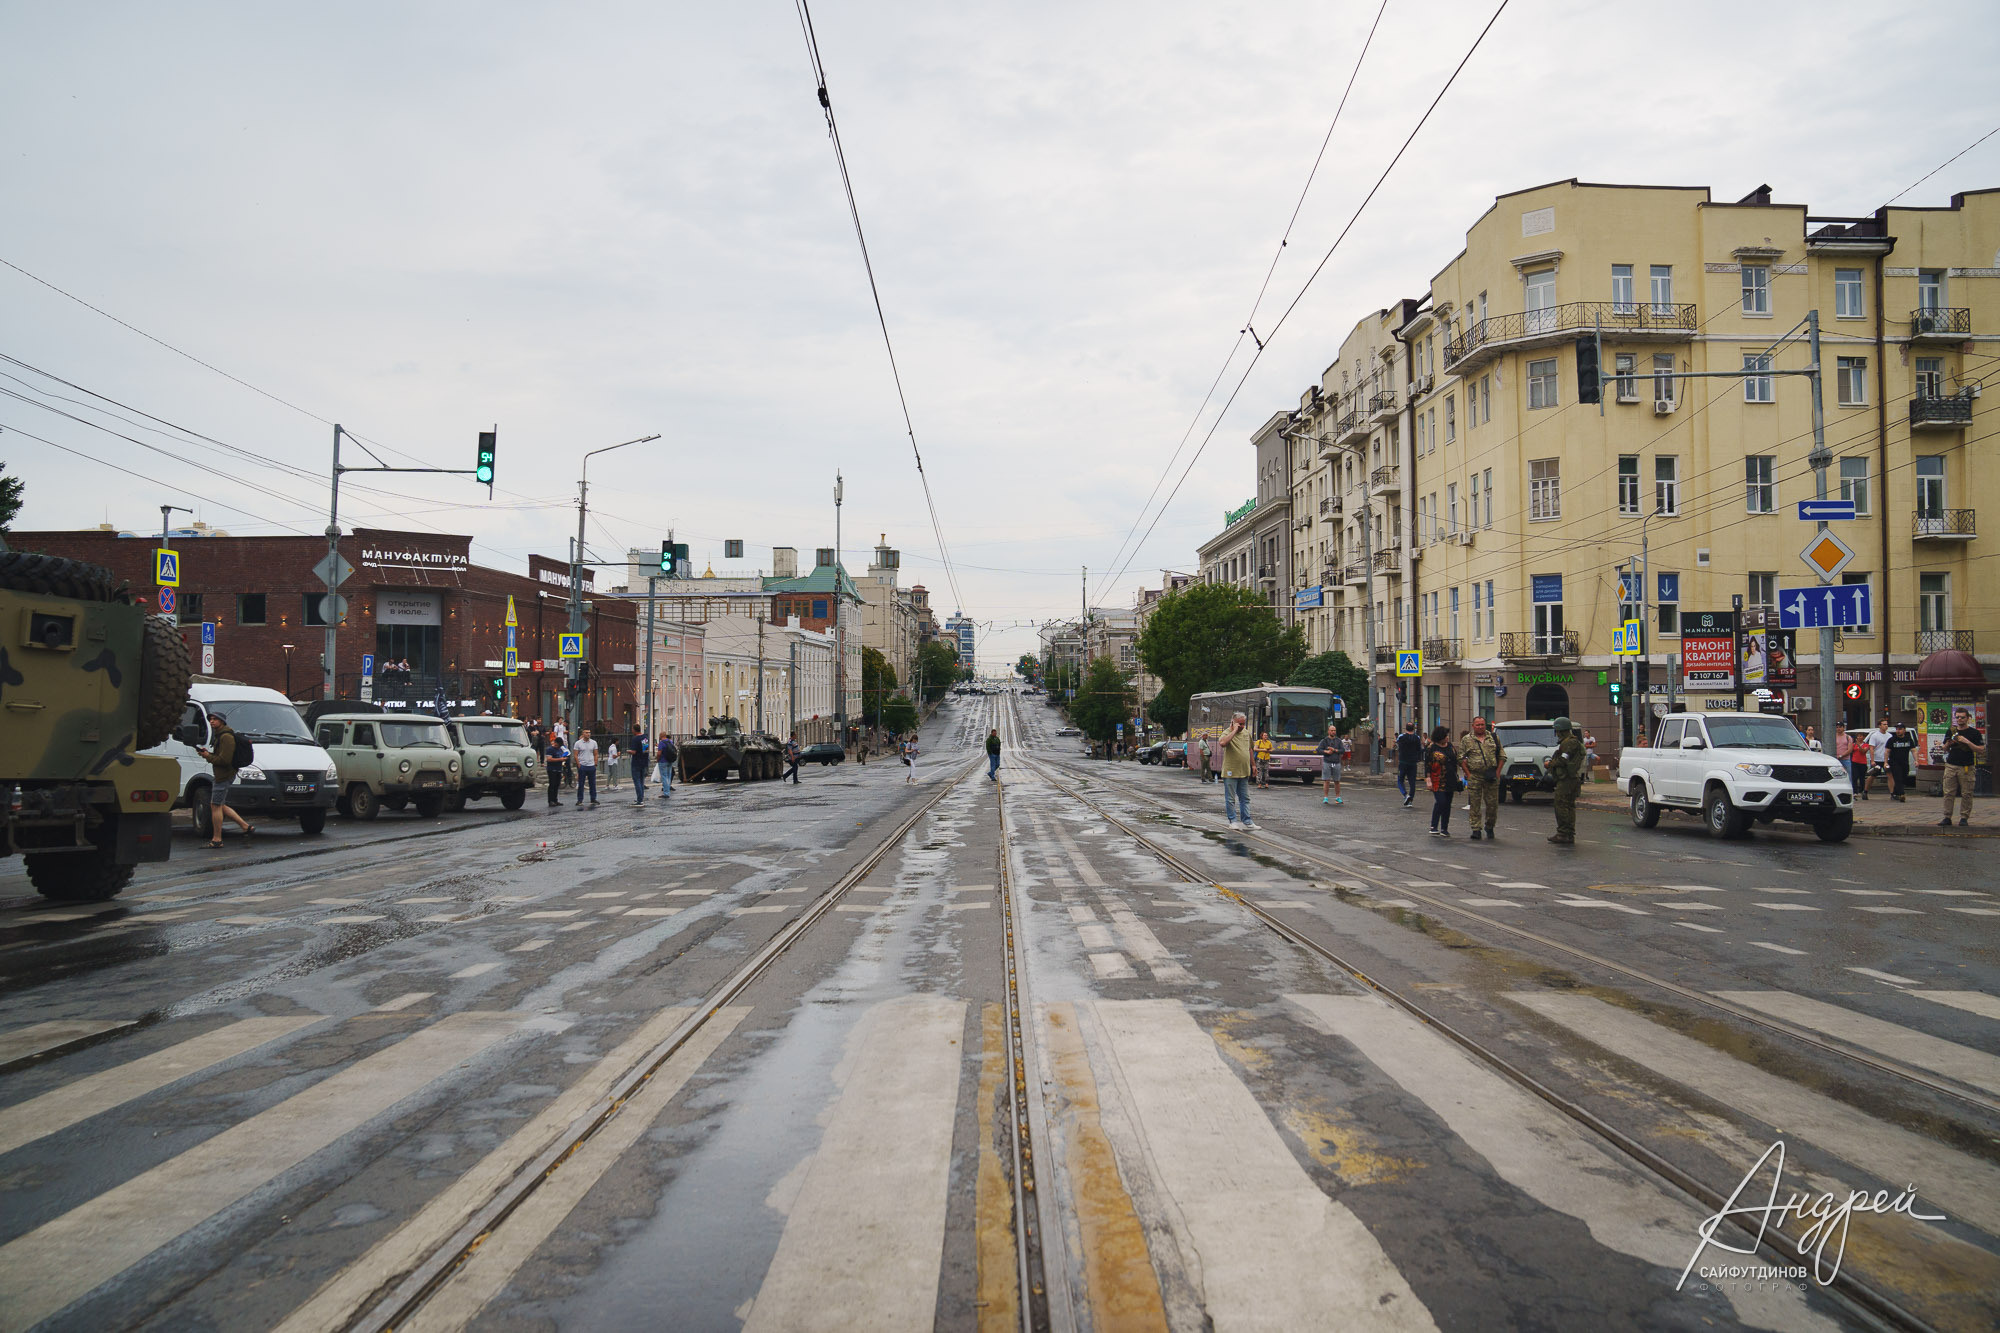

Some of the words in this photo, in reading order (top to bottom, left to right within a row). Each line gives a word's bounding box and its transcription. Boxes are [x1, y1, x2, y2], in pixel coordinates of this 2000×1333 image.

[362, 549, 468, 564] МАНУФАКТУРА
[387, 600, 431, 608] открытие
[1685, 641, 1731, 651] РЕМОНТ
[1685, 652, 1731, 661] КВАРТИР
[1517, 672, 1574, 684] ВкусВилл
[1835, 671, 1860, 681] ЕПЛЫЙ
[1705, 699, 1737, 709] КОФЕ
